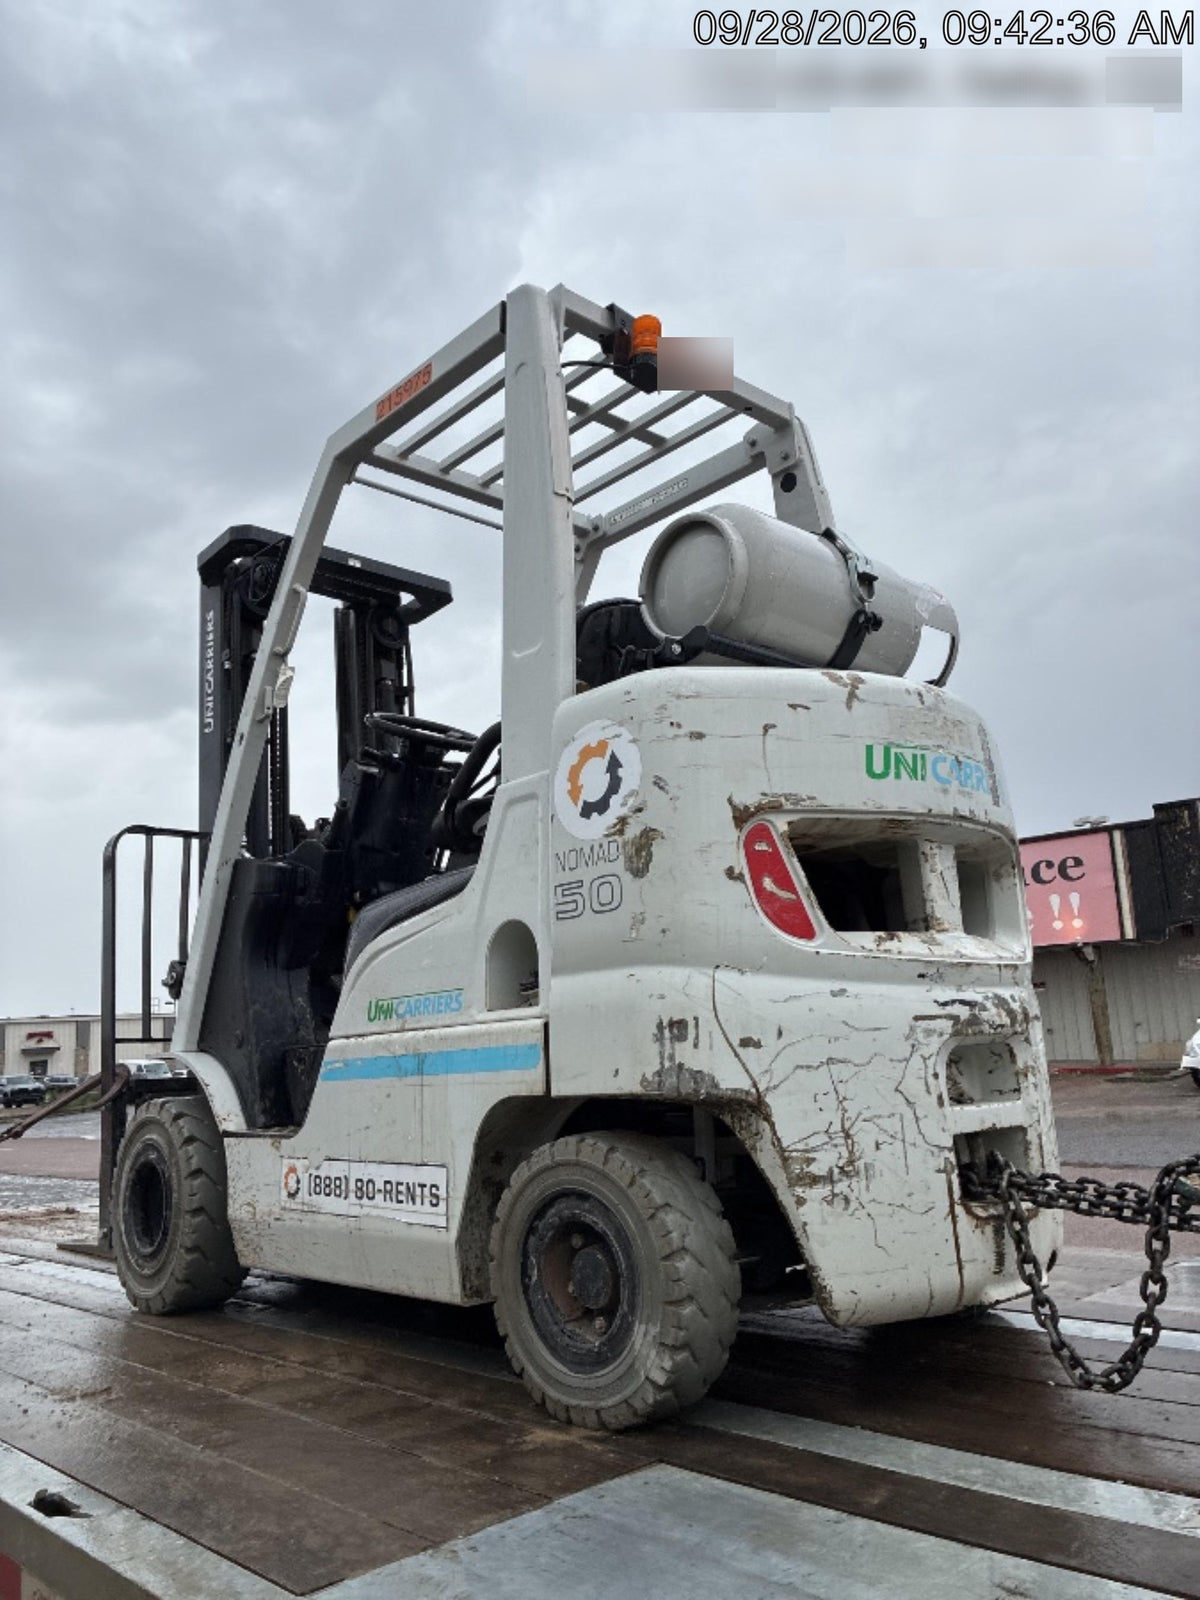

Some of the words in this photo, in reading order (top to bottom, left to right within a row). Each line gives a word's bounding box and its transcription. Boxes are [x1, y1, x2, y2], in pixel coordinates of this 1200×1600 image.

[203, 609, 214, 733] UNICARRIERS
[554, 839, 620, 873] NOMAD
[554, 873, 623, 921] 50
[367, 990, 464, 1023] UNICARRIERS
[308, 1173, 350, 1201] (888)
[354, 1177, 441, 1208] 80-RENTS
